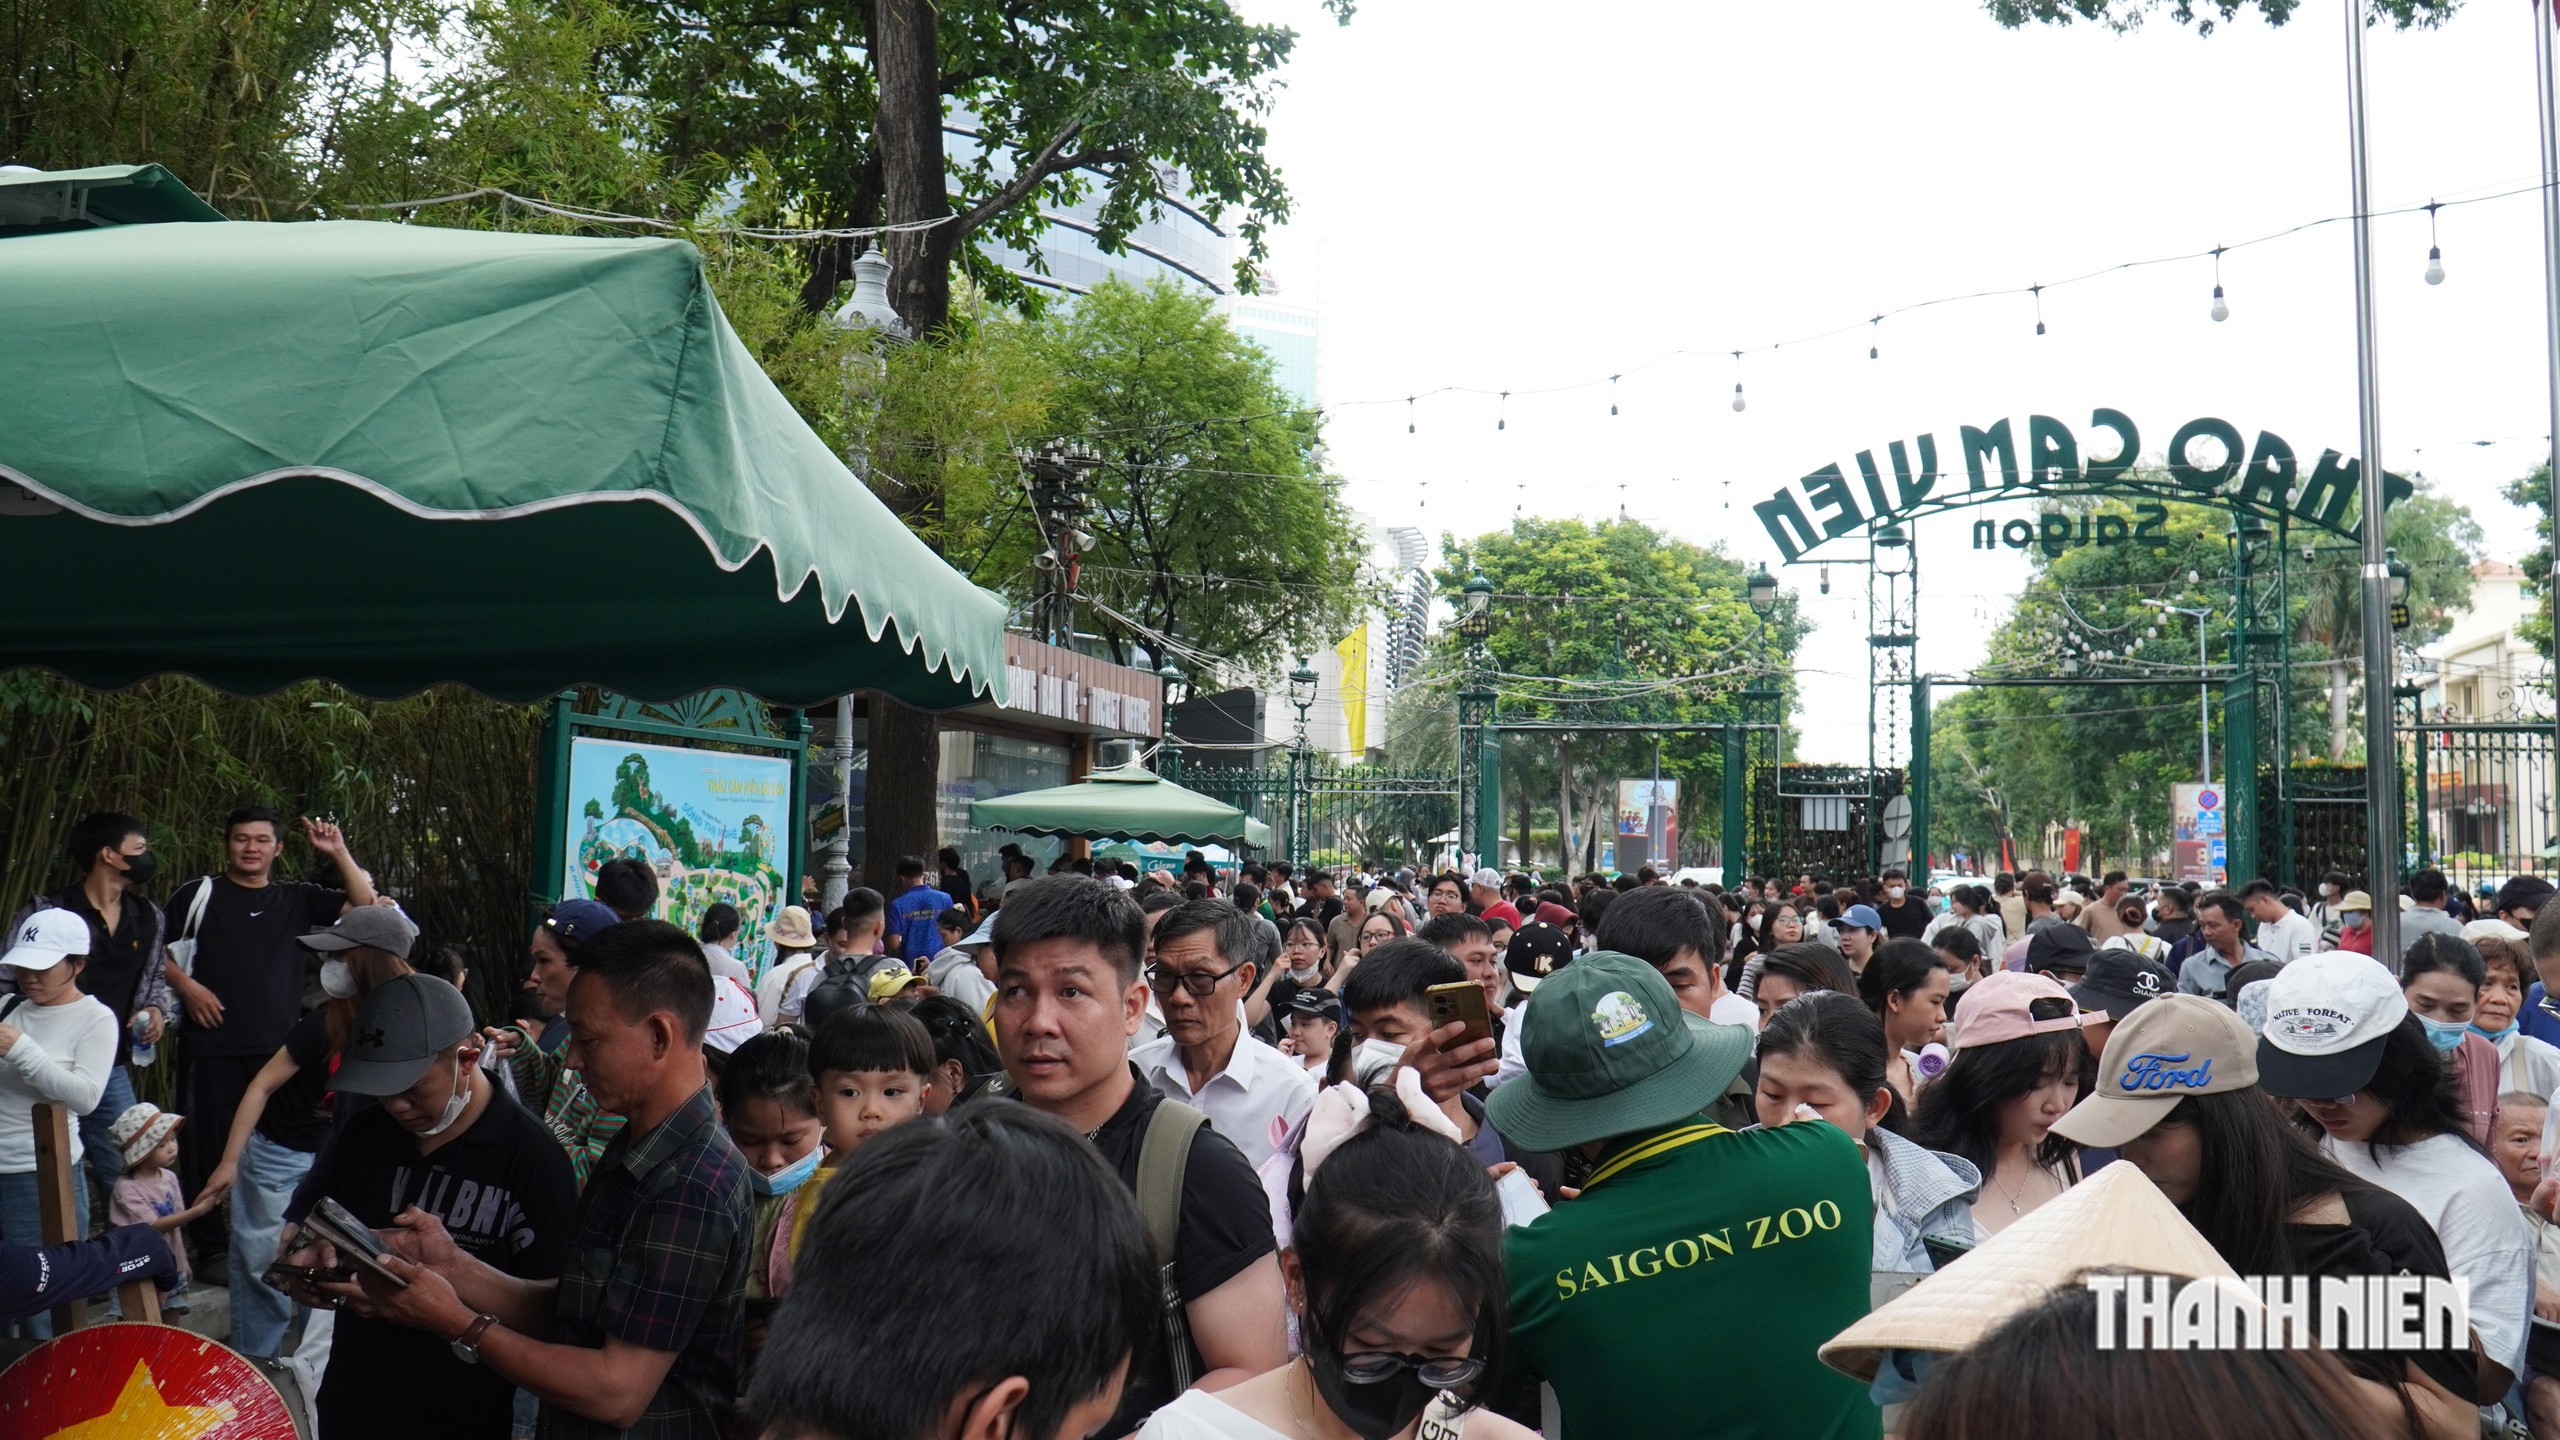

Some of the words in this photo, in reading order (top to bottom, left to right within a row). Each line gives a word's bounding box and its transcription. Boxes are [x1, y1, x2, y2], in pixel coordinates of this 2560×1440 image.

[1121, 694, 1151, 736] OFFICE
[2273, 1008, 2300, 1021] NATIVE
[2120, 1053, 2212, 1091] Ford
[1556, 1227, 1735, 1301] SAIGON
[1746, 1199, 1842, 1249] ZOO
